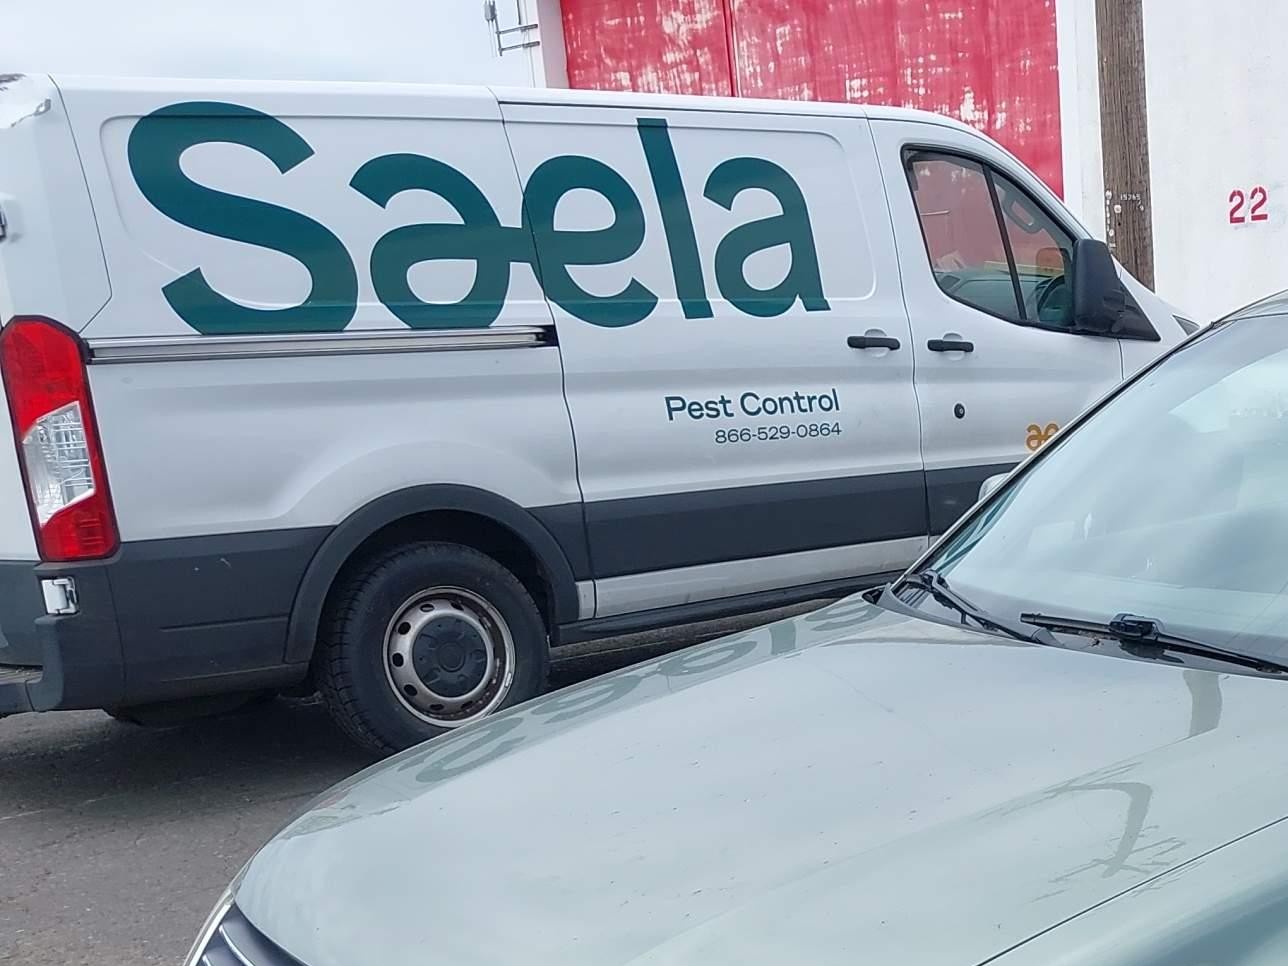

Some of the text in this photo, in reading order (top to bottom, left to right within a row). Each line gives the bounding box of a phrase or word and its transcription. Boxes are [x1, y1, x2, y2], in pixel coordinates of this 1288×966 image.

[127, 100, 831, 333] Saela
[1229, 187, 1268, 224] 22
[665, 388, 840, 421] Pest Control
[715, 422, 842, 444] 866-529-0864
